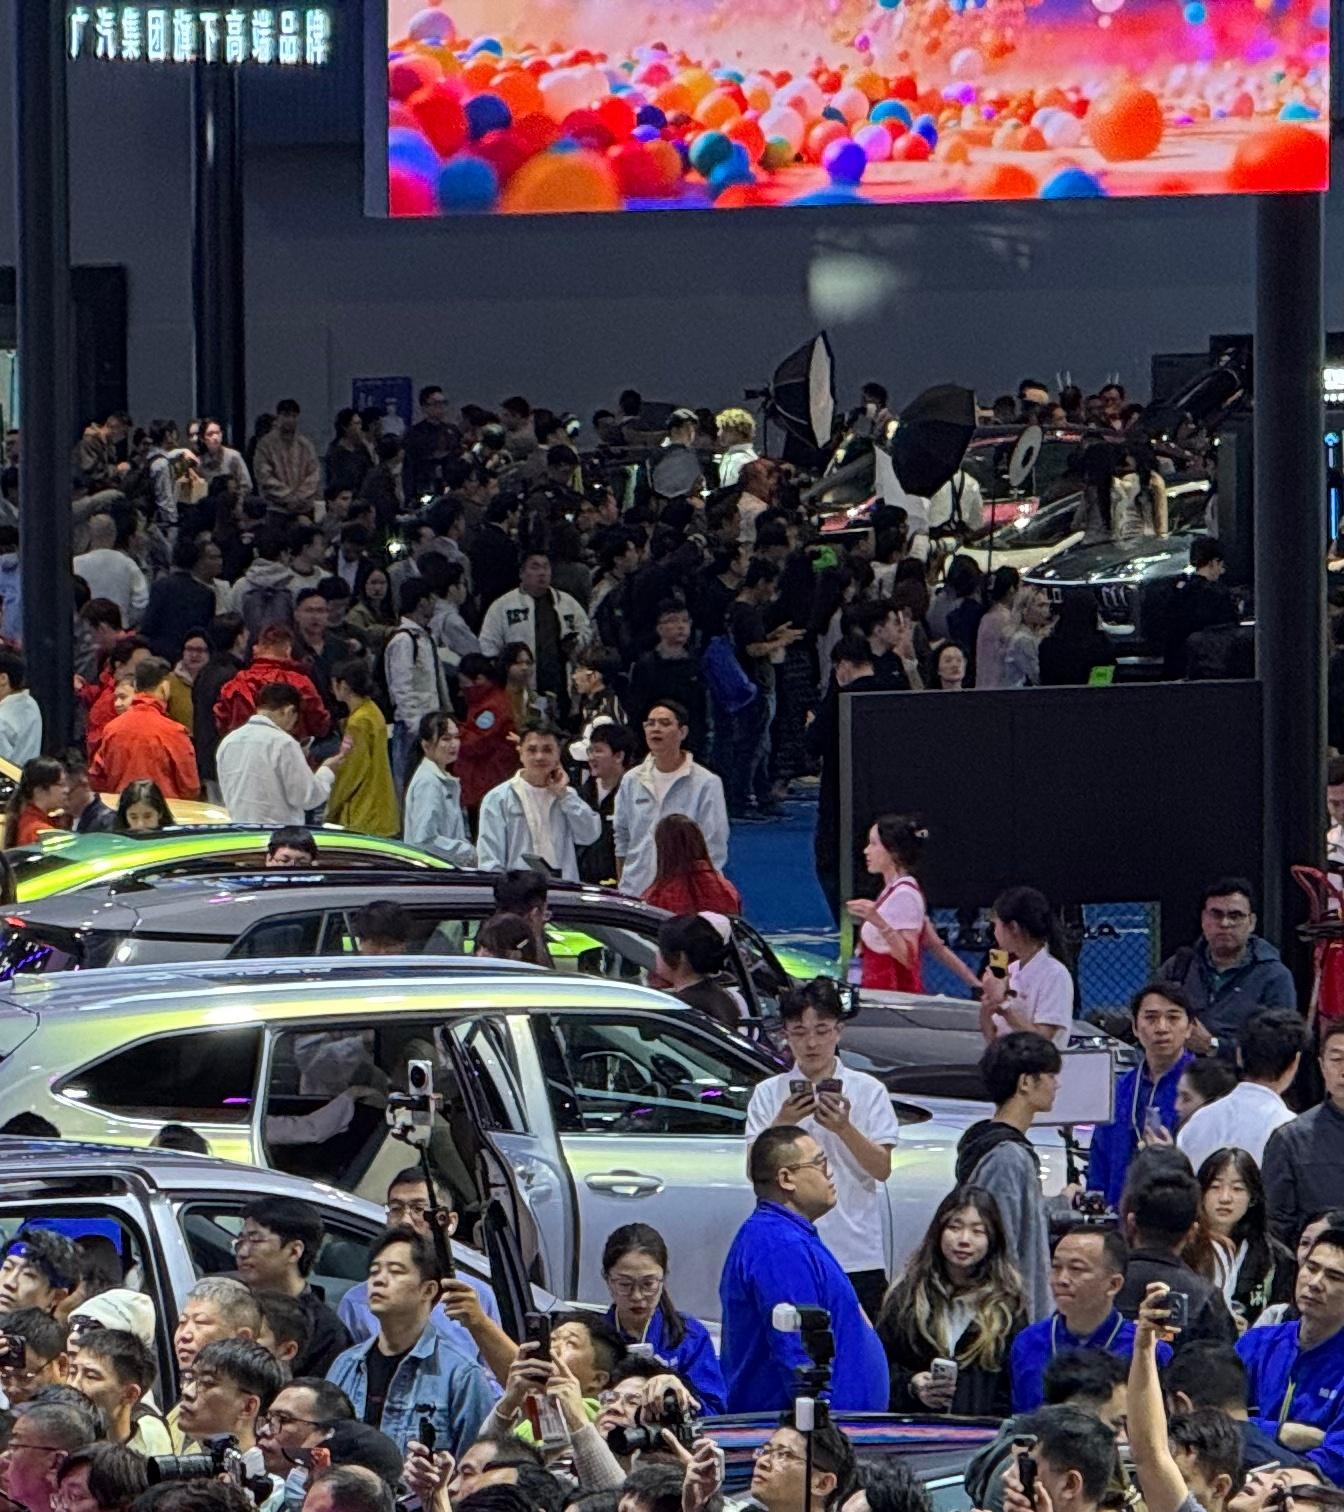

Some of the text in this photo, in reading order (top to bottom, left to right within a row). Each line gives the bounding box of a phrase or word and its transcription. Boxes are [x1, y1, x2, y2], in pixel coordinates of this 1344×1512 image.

[68, 7, 329, 64] 广汽集团旗下高端品牌
